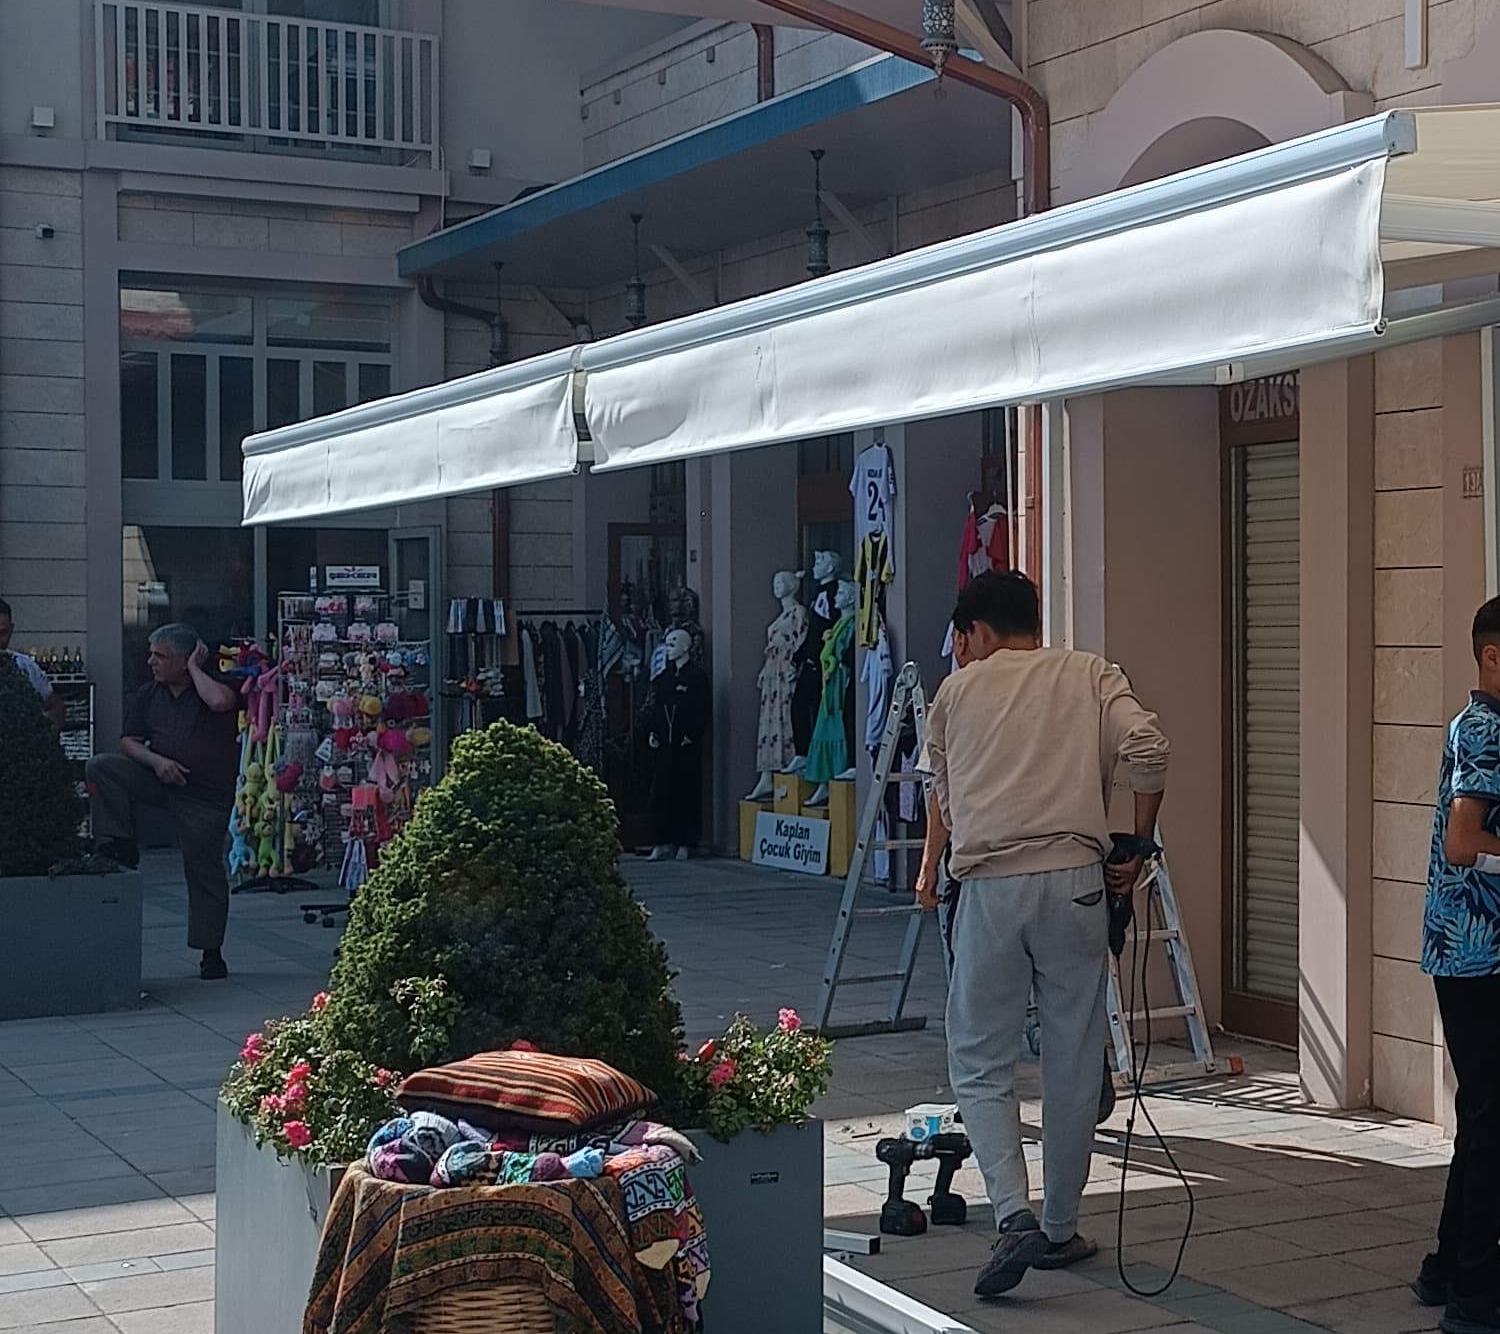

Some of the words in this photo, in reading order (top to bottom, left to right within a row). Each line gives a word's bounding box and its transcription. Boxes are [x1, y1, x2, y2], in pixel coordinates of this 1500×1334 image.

[775, 819, 810, 842] Kaplan
[760, 837, 790, 859] Çocuk
[793, 843, 821, 866] Giyim
